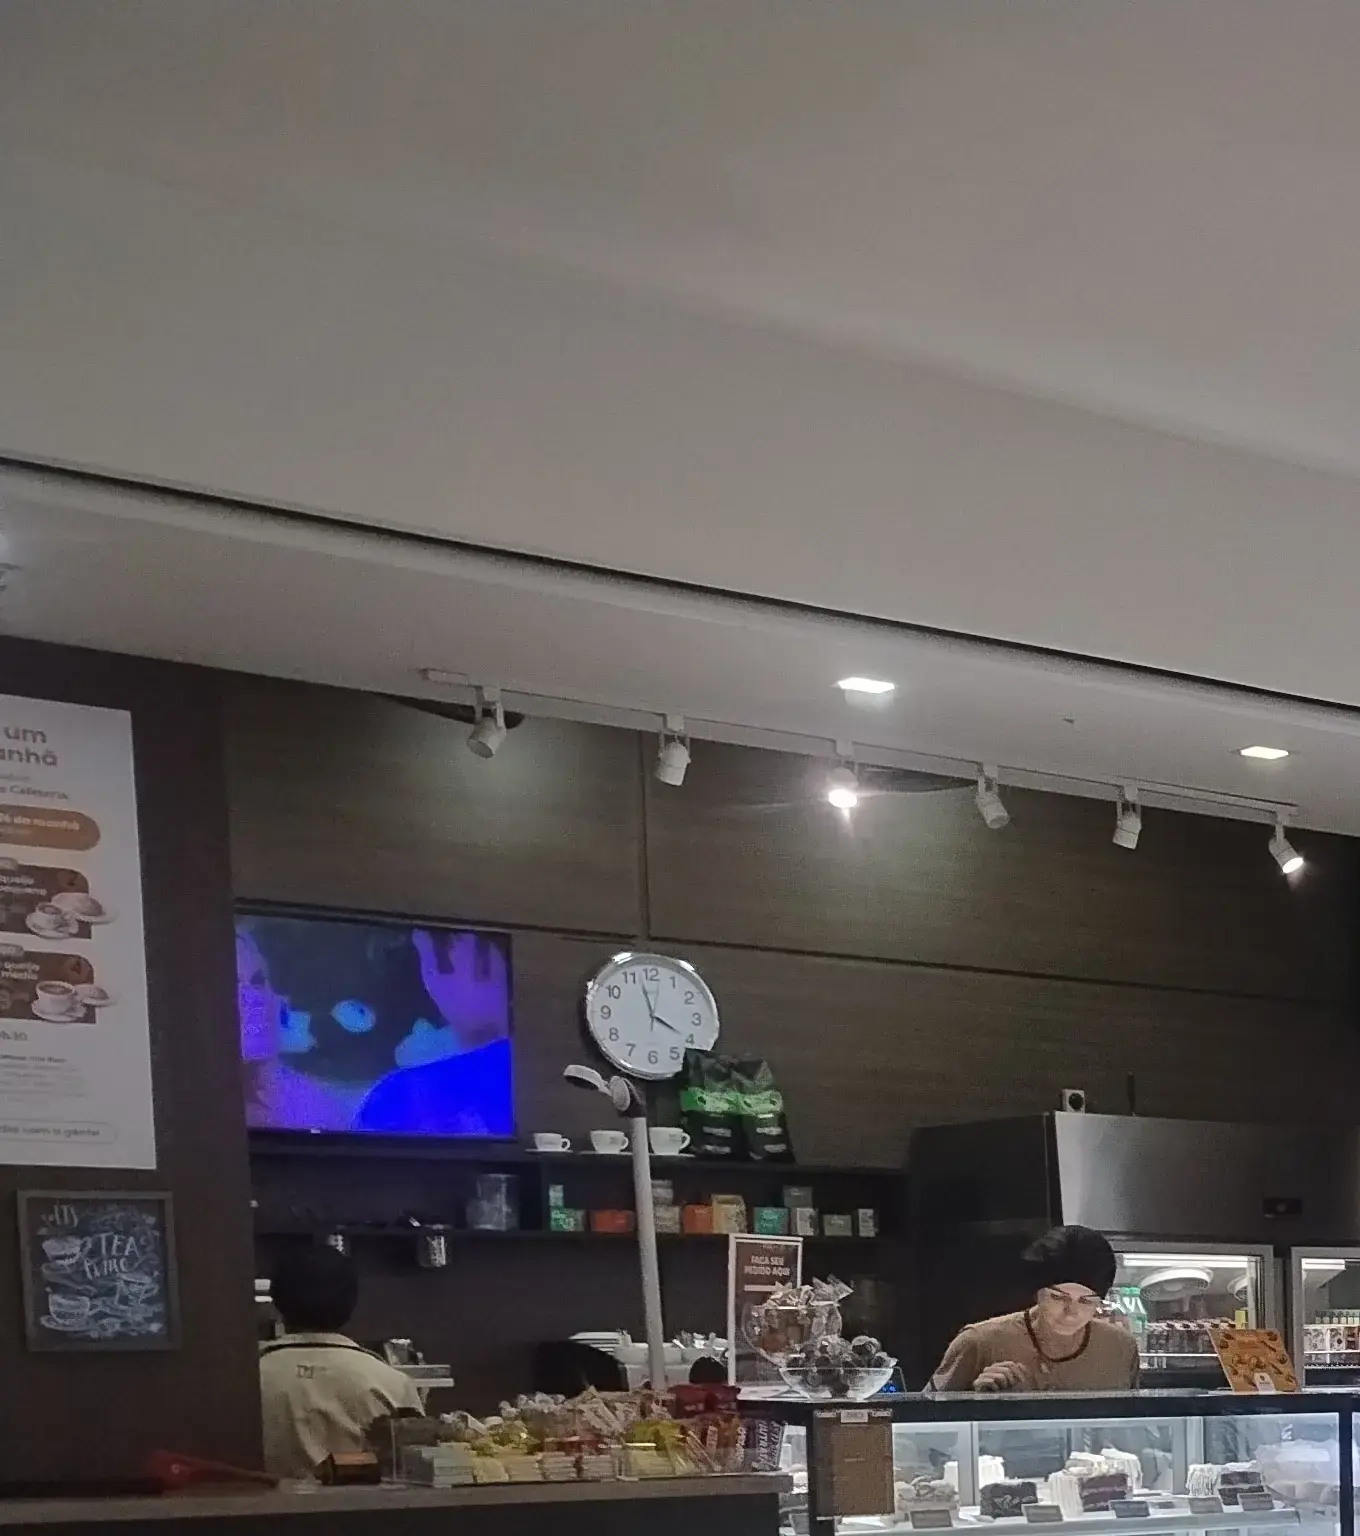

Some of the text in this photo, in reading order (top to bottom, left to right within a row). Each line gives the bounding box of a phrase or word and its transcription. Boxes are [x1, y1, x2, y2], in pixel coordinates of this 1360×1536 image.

[4, 727, 47, 743] um
[622, 971, 636, 984] 11
[643, 968, 659, 981] 12
[670, 976, 676, 989] 1
[606, 985, 621, 999] 10
[684, 991, 694, 1005] 2
[600, 1005, 611, 1019] 9
[691, 1012, 701, 1026] 3
[609, 1027, 619, 1041] 8
[685, 1033, 695, 1045] 4
[626, 1043, 636, 1056] 7
[669, 1046, 680, 1060] 5
[648, 1050, 658, 1064] 6
[100, 1232, 140, 1256] TEA
